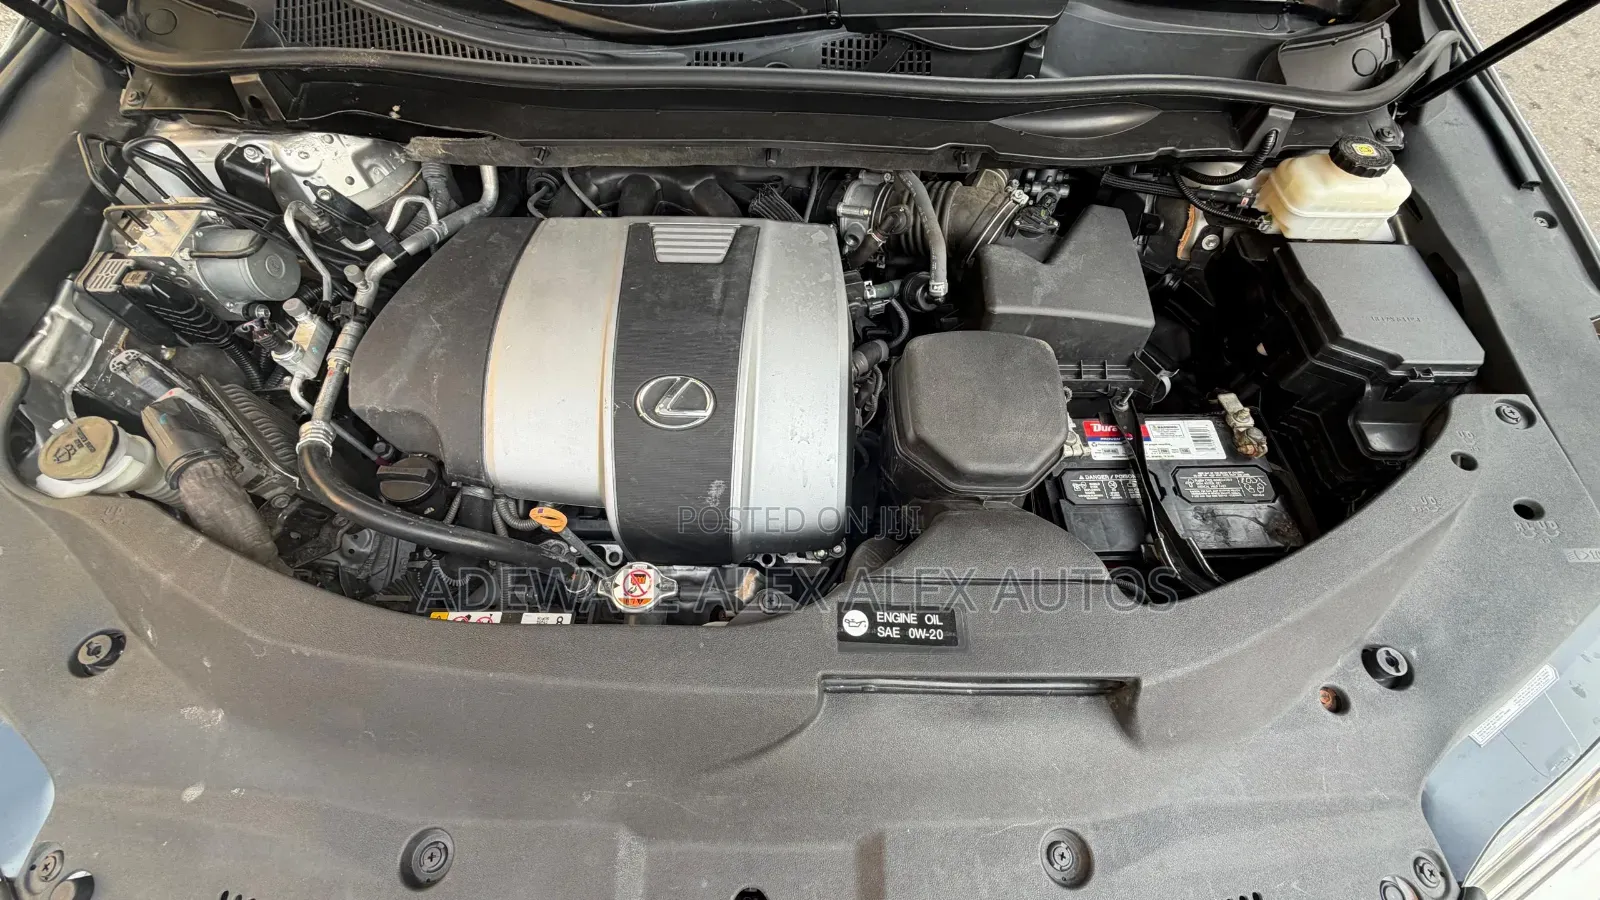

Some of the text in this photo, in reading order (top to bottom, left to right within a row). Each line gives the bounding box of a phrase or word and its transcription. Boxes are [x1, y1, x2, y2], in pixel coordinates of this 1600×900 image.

[876, 611, 944, 626] ENGINE OIL
[877, 625, 944, 640] SAE 0W-20
